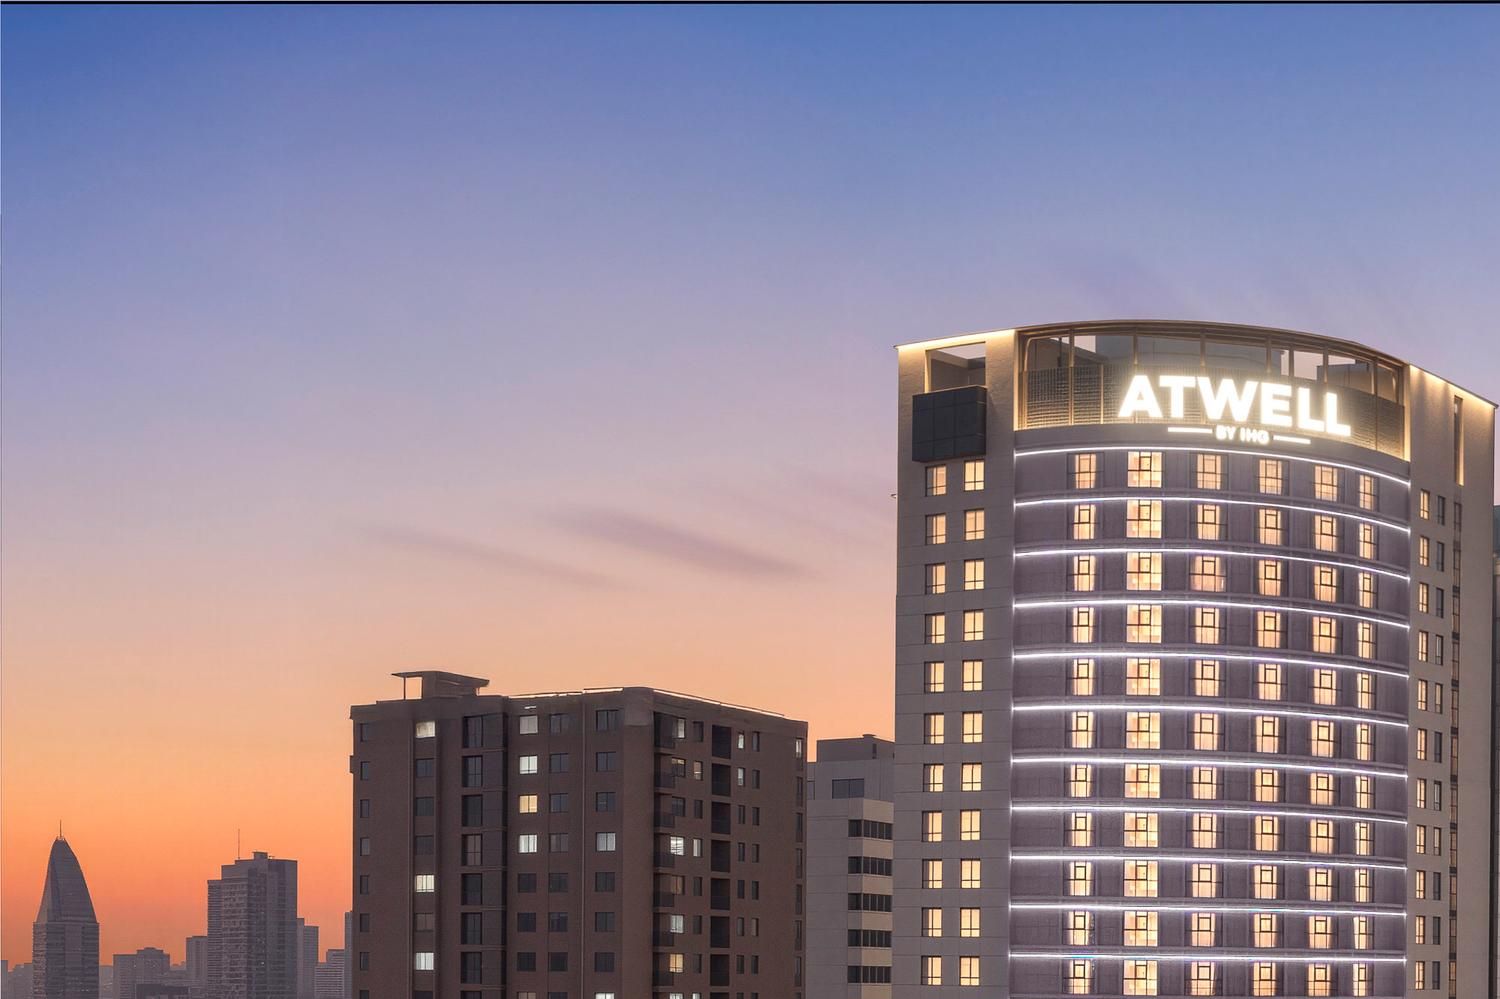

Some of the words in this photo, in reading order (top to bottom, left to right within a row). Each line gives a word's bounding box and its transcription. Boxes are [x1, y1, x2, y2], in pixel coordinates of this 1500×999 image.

[1118, 374, 1351, 437] ATWELL
[1216, 424, 1236, 440] BY
[1240, 427, 1270, 445] IHG
